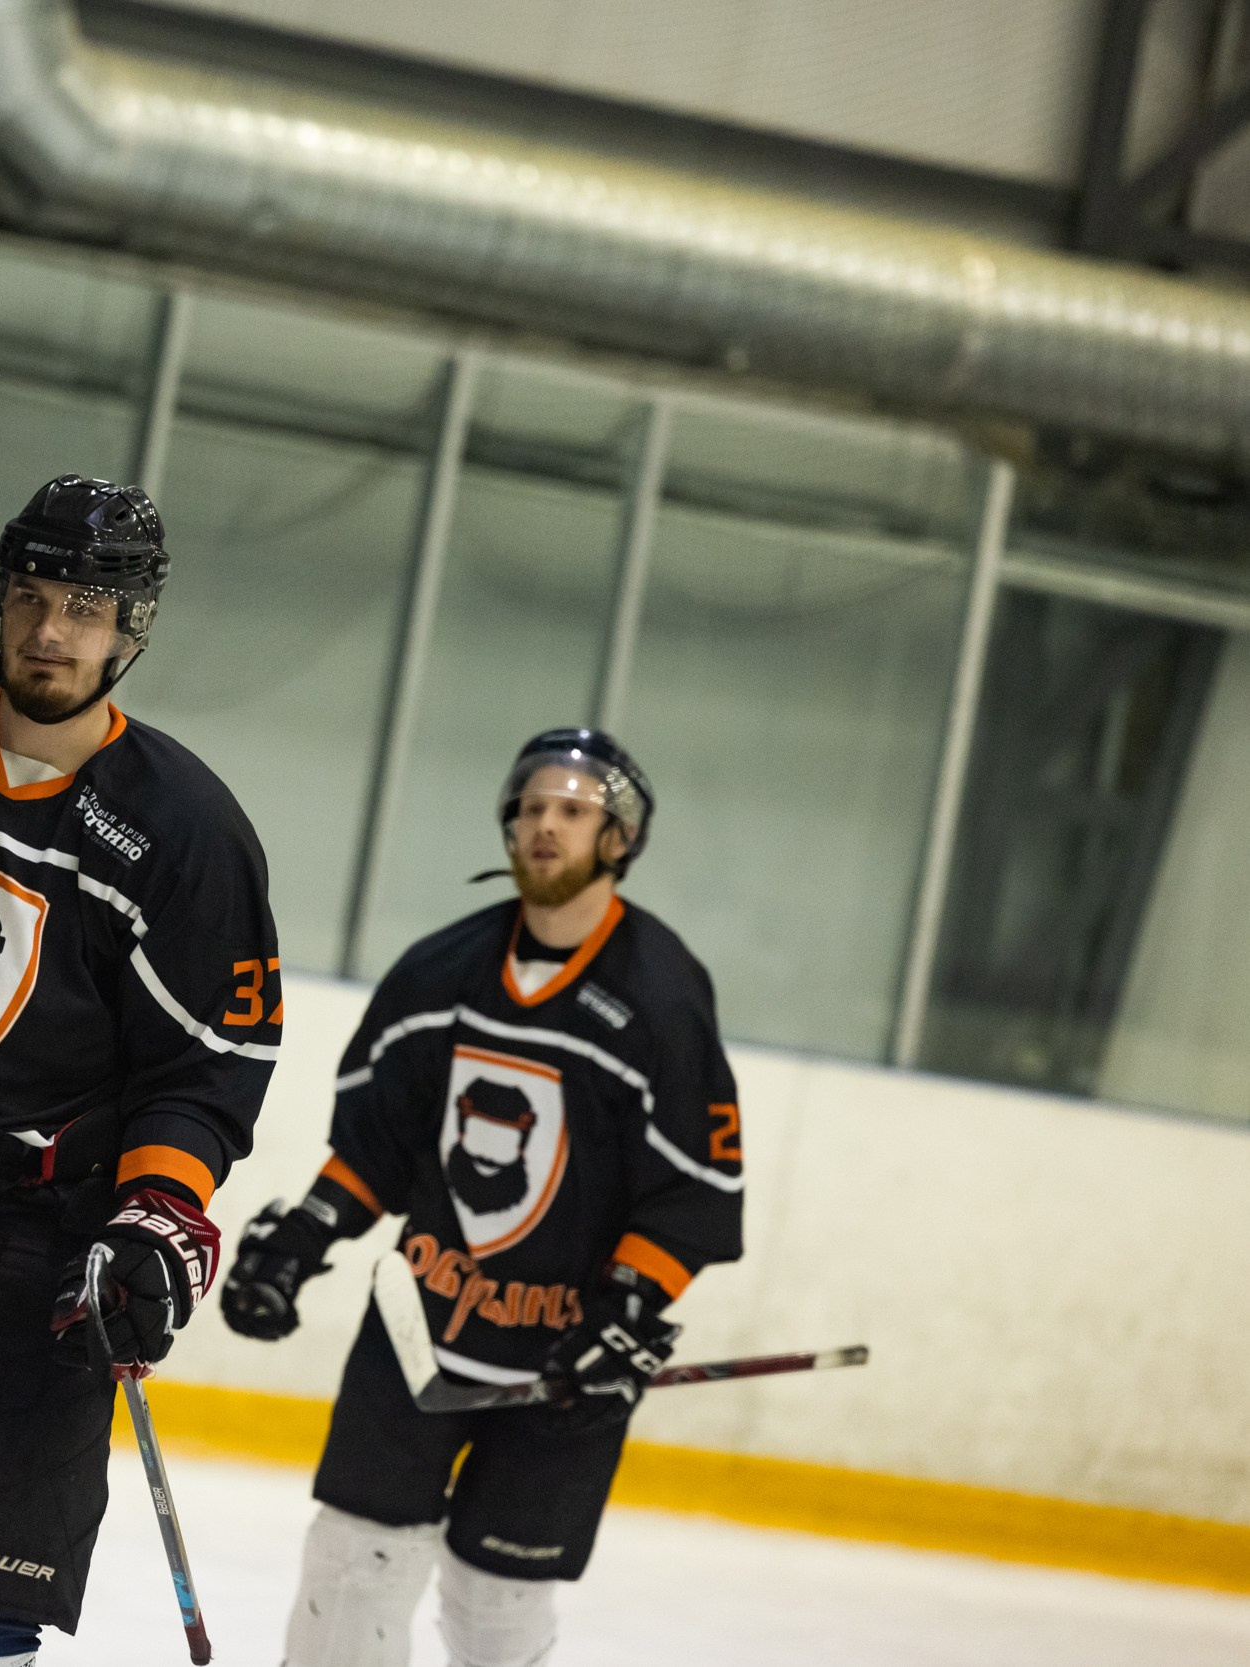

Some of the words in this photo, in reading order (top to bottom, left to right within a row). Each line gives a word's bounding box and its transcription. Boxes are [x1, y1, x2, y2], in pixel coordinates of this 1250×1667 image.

[117, 823, 152, 852] АРЕНА
[707, 1103, 743, 1161] 2
[106, 1209, 203, 1311] BAUER
[152, 1486, 170, 1516] BAUER
